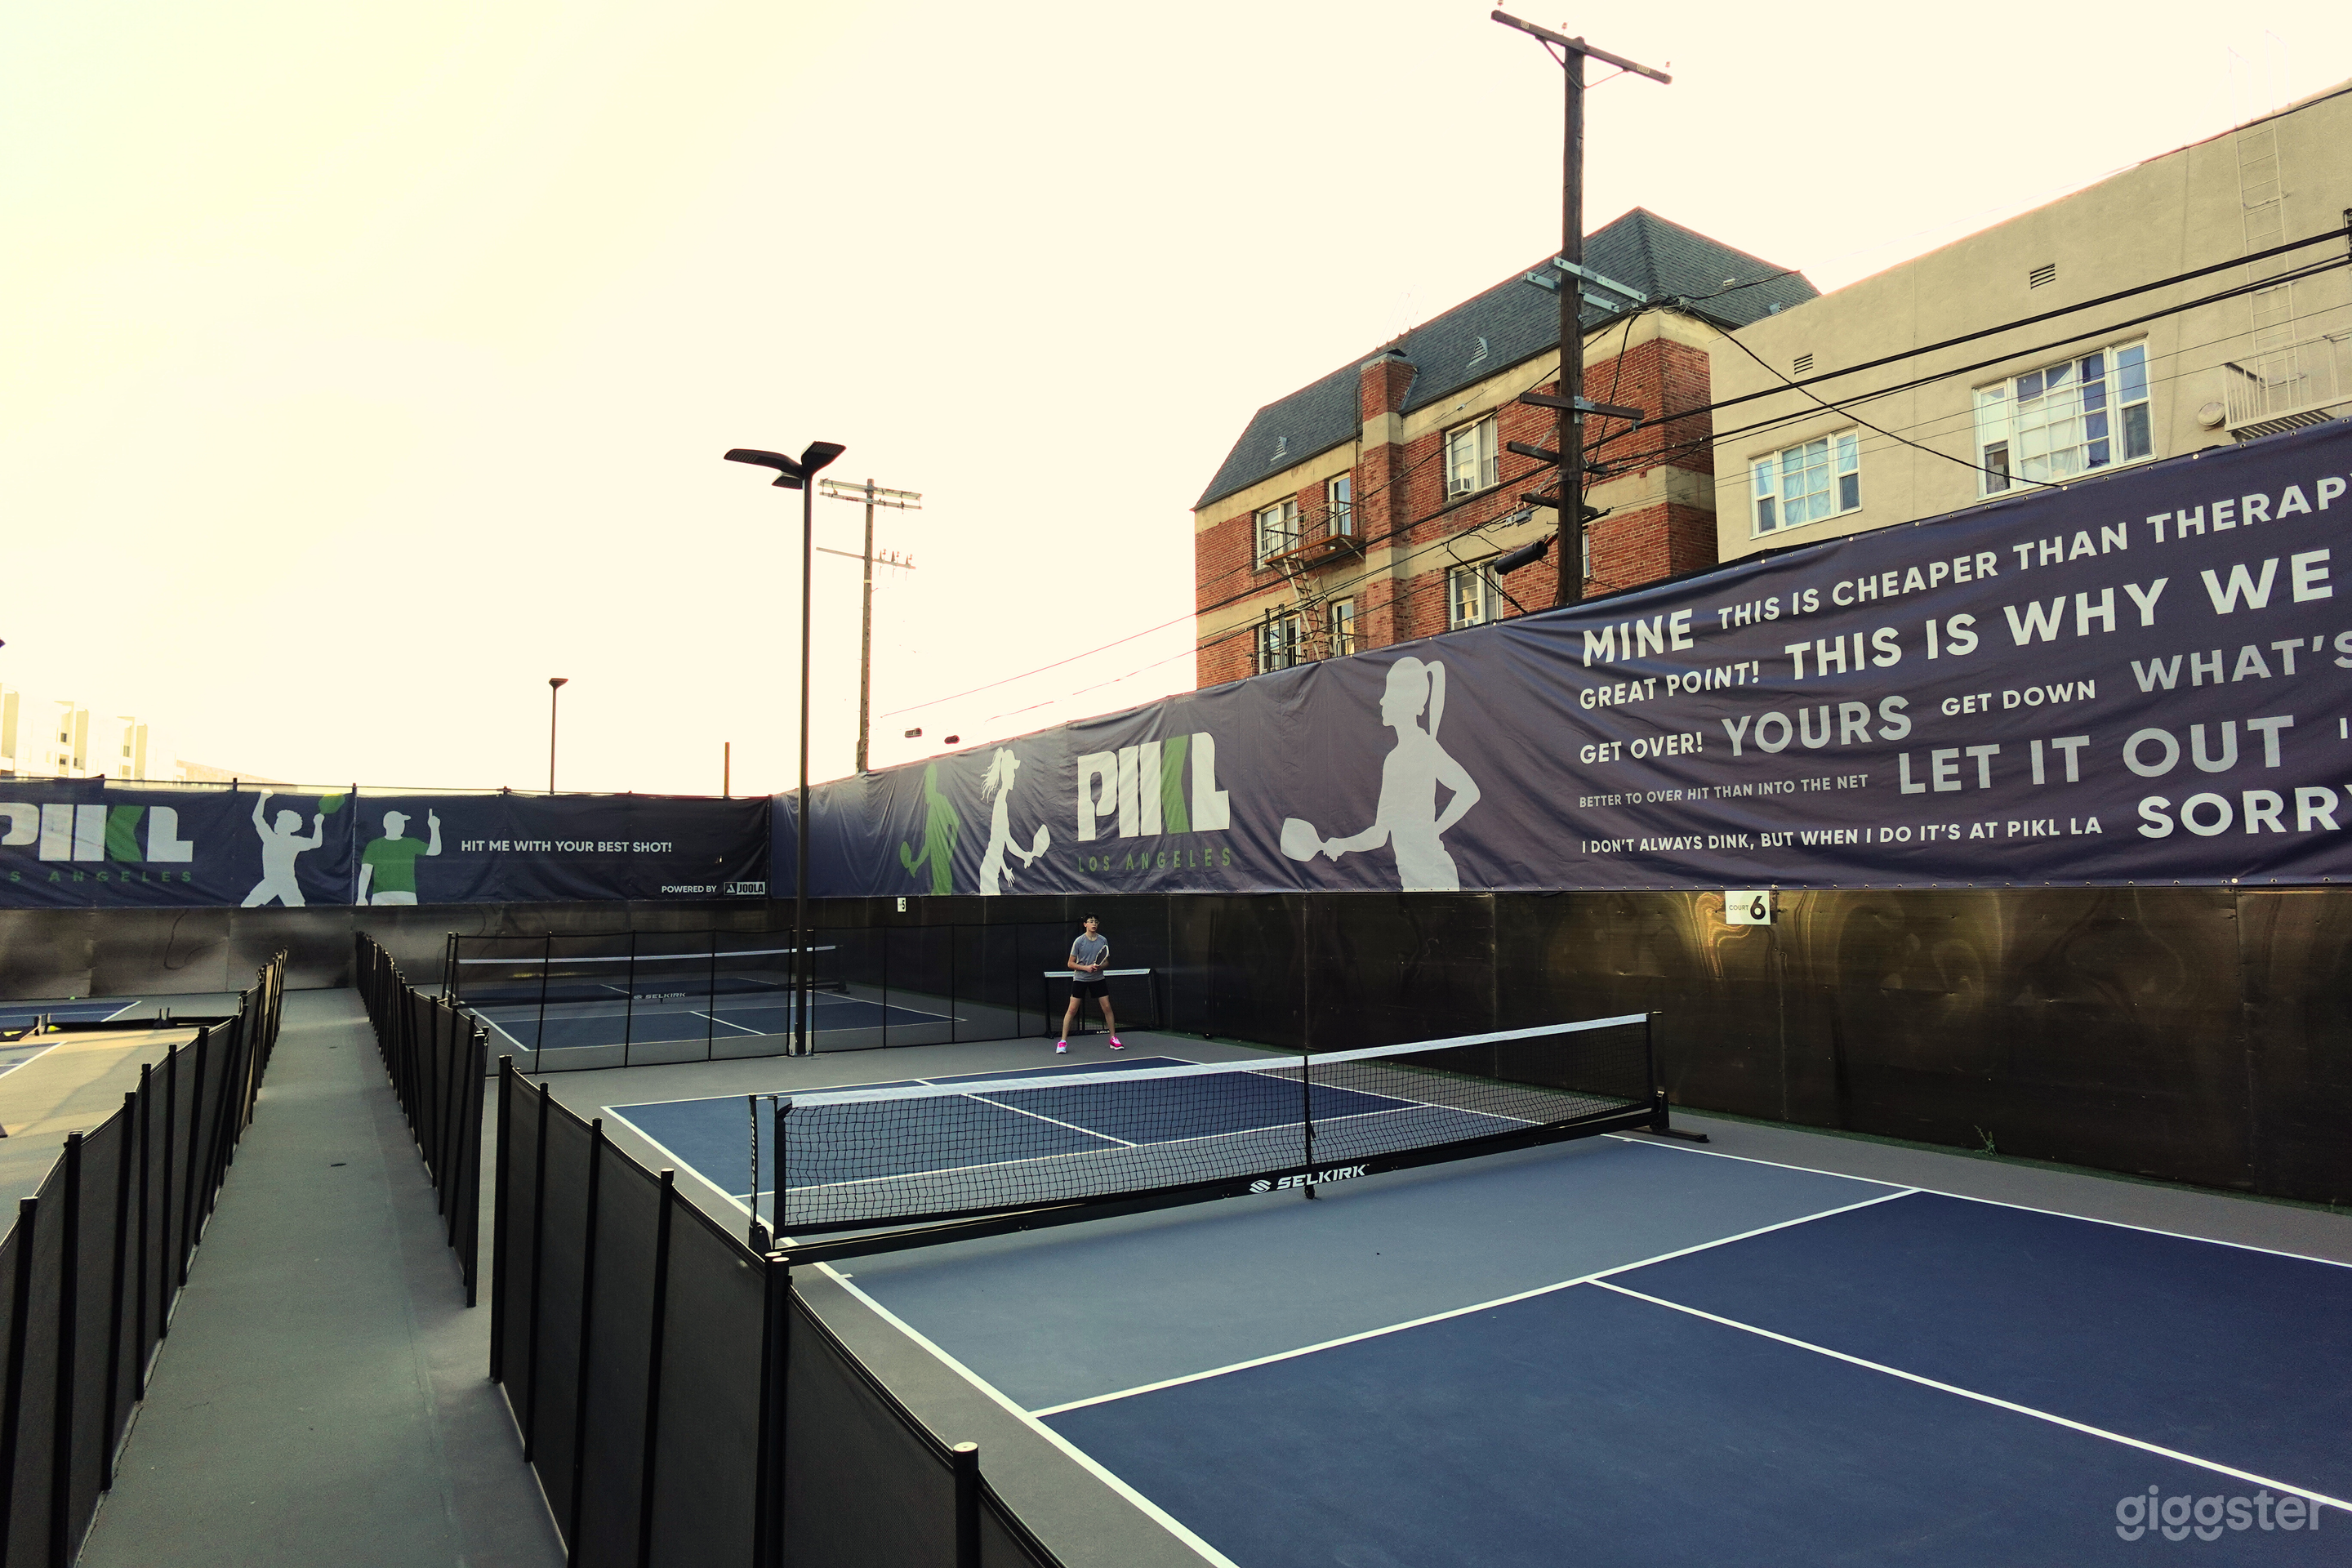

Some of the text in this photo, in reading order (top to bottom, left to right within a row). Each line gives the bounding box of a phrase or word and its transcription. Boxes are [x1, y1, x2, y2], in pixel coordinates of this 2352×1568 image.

[1718, 472, 2352, 630] THIS IS CHEAPER THAN THERAP
[1784, 548, 2333, 681] THIS IS WHY WE
[1583, 608, 1694, 667] MINE
[1579, 660, 1759, 710] GREAT POINT!
[1941, 679, 2096, 716] GET DOWN
[1721, 695, 1912, 757] YOURS
[1579, 731, 1703, 764] GET OVER!
[1898, 715, 2294, 795] LET IT OUT
[1077, 731, 1231, 842] PIKL
[1579, 773, 1869, 808] BETTER TO OVER HIT THAN INTO THE NET
[2136, 785, 2352, 839] SORR
[461, 840, 672, 853] HIT ME WITH YOUR BEST SHOT!
[1581, 816, 2103, 853] I DON'T ALWAYS DINK, BUT WHEN I DO IT'S AT PIKL LA
[48, 871, 192, 882] ANGELES
[1078, 847, 1231, 873] LOS ANGELES
[738, 884, 764, 893] JOOLA
[902, 899, 906, 910] 5
[1750, 895, 1766, 920] 6
[1276, 1164, 1366, 1190] SELKIRK
